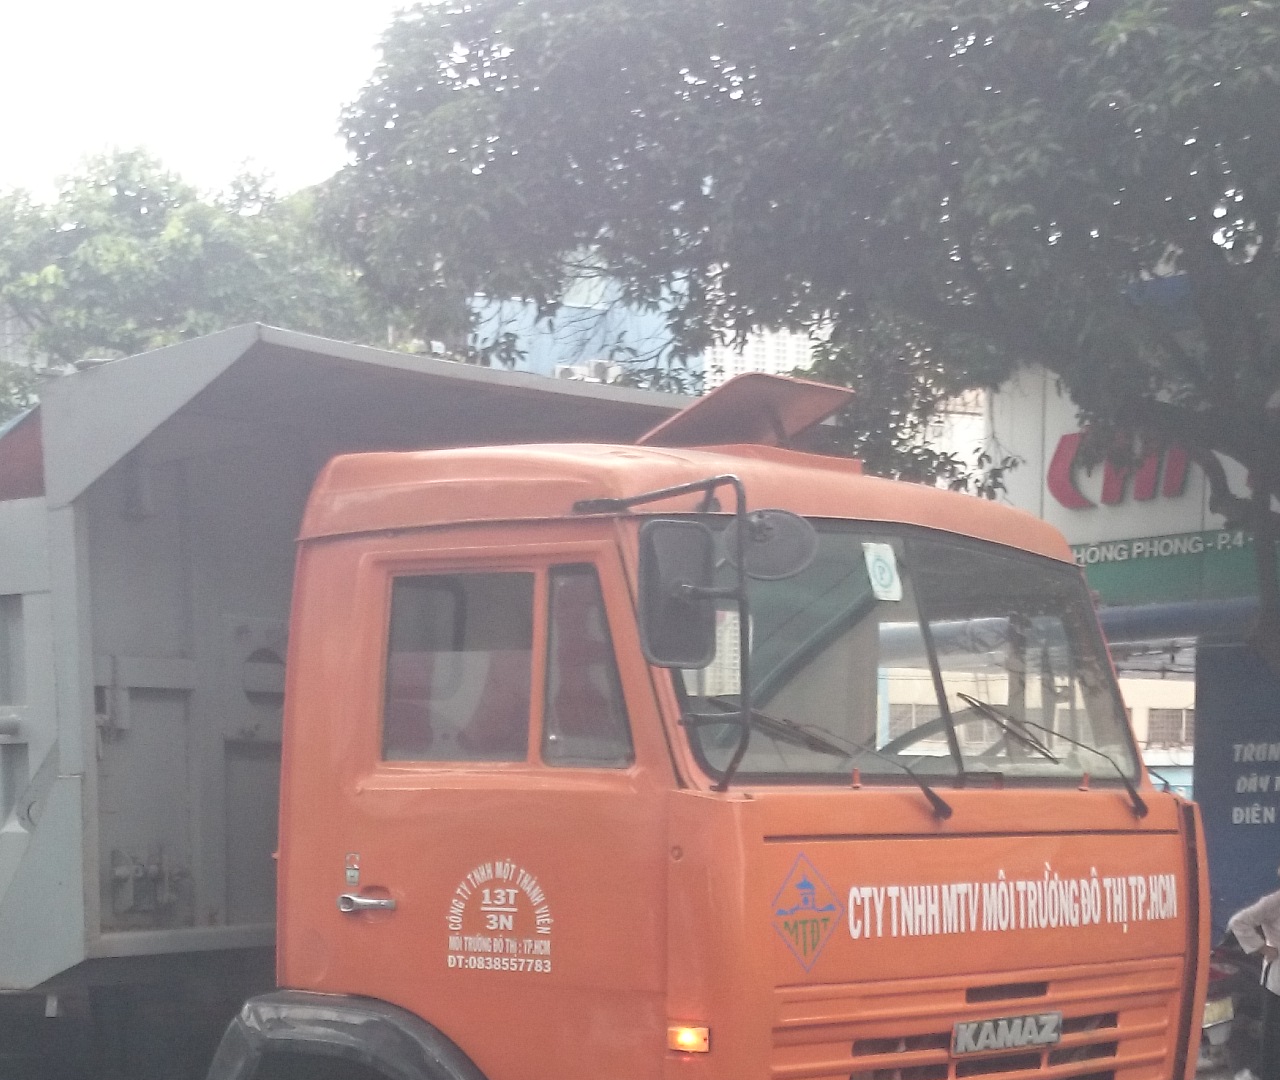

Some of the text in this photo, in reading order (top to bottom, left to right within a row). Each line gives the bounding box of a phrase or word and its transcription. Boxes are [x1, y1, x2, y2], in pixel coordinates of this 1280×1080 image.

[1132, 537, 1204, 558] PHONG
[1217, 532, 1244, 550] P.4
[446, 898, 466, 931] CÔNG
[456, 881, 472, 900] TY
[467, 863, 493, 888] TNHH
[534, 905, 554, 934] VIÊN
[482, 889, 519, 905] 13T
[848, 861, 1178, 939] CTY TNHH MTV MÔI TRƯỜNG ĐÔ THỊ TP.HCM
[486, 914, 513, 931] 3N
[447, 955, 552, 973] ĐT:0838557783
[956, 1013, 1059, 1053] KAMAZ
